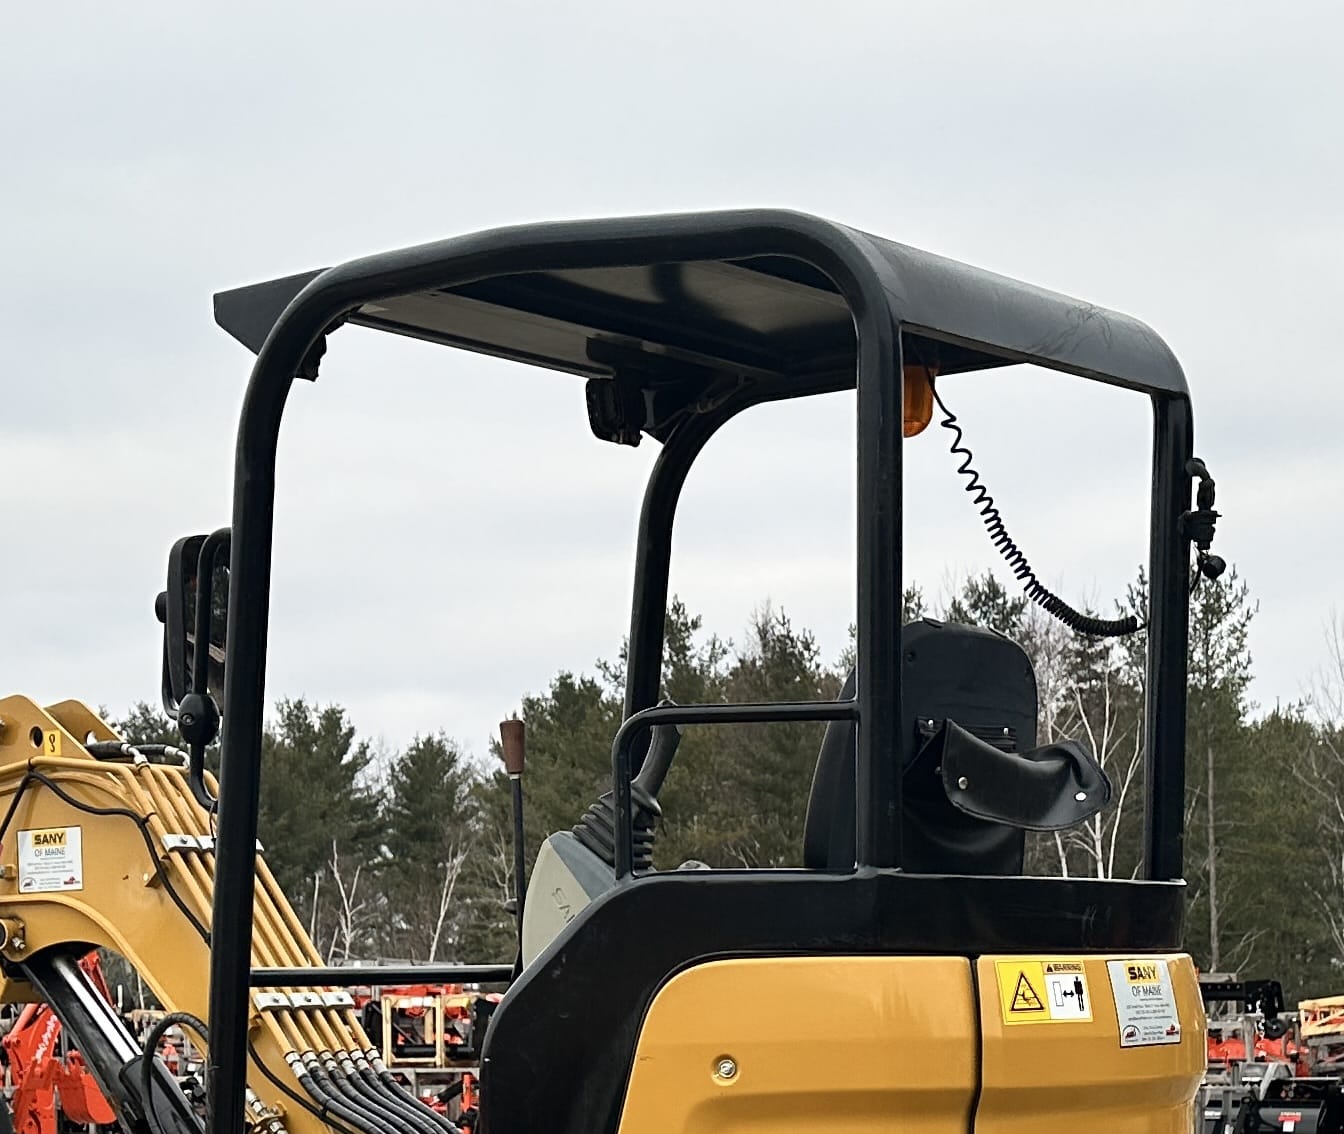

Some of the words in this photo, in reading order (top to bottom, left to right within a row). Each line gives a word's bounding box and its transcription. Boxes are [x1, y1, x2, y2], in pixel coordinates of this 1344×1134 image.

[34, 832, 65, 845] SANY
[34, 848, 44, 857] OF
[44, 847, 65, 856] MAINE
[552, 887, 576, 924] SA
[1127, 966, 1157, 981] SANY
[1131, 986, 1142, 997] OF
